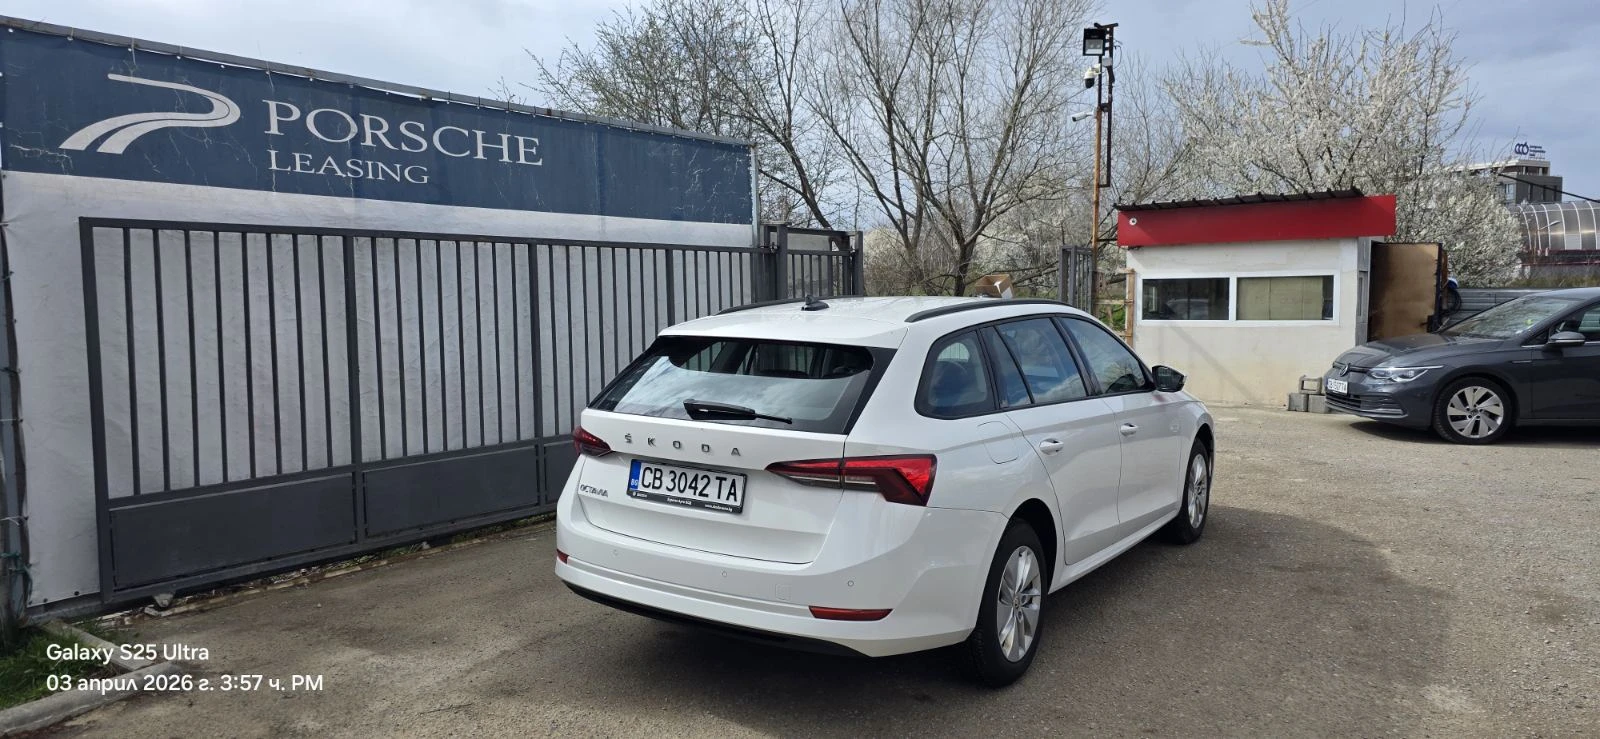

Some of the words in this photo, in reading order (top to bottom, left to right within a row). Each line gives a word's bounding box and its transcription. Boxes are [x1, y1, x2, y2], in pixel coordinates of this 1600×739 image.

[262, 99, 543, 166] PORSCHE
[267, 149, 430, 184] LEASING
[641, 466, 663, 490] CB
[665, 470, 711, 498] 3042
[715, 476, 738, 502] TA
